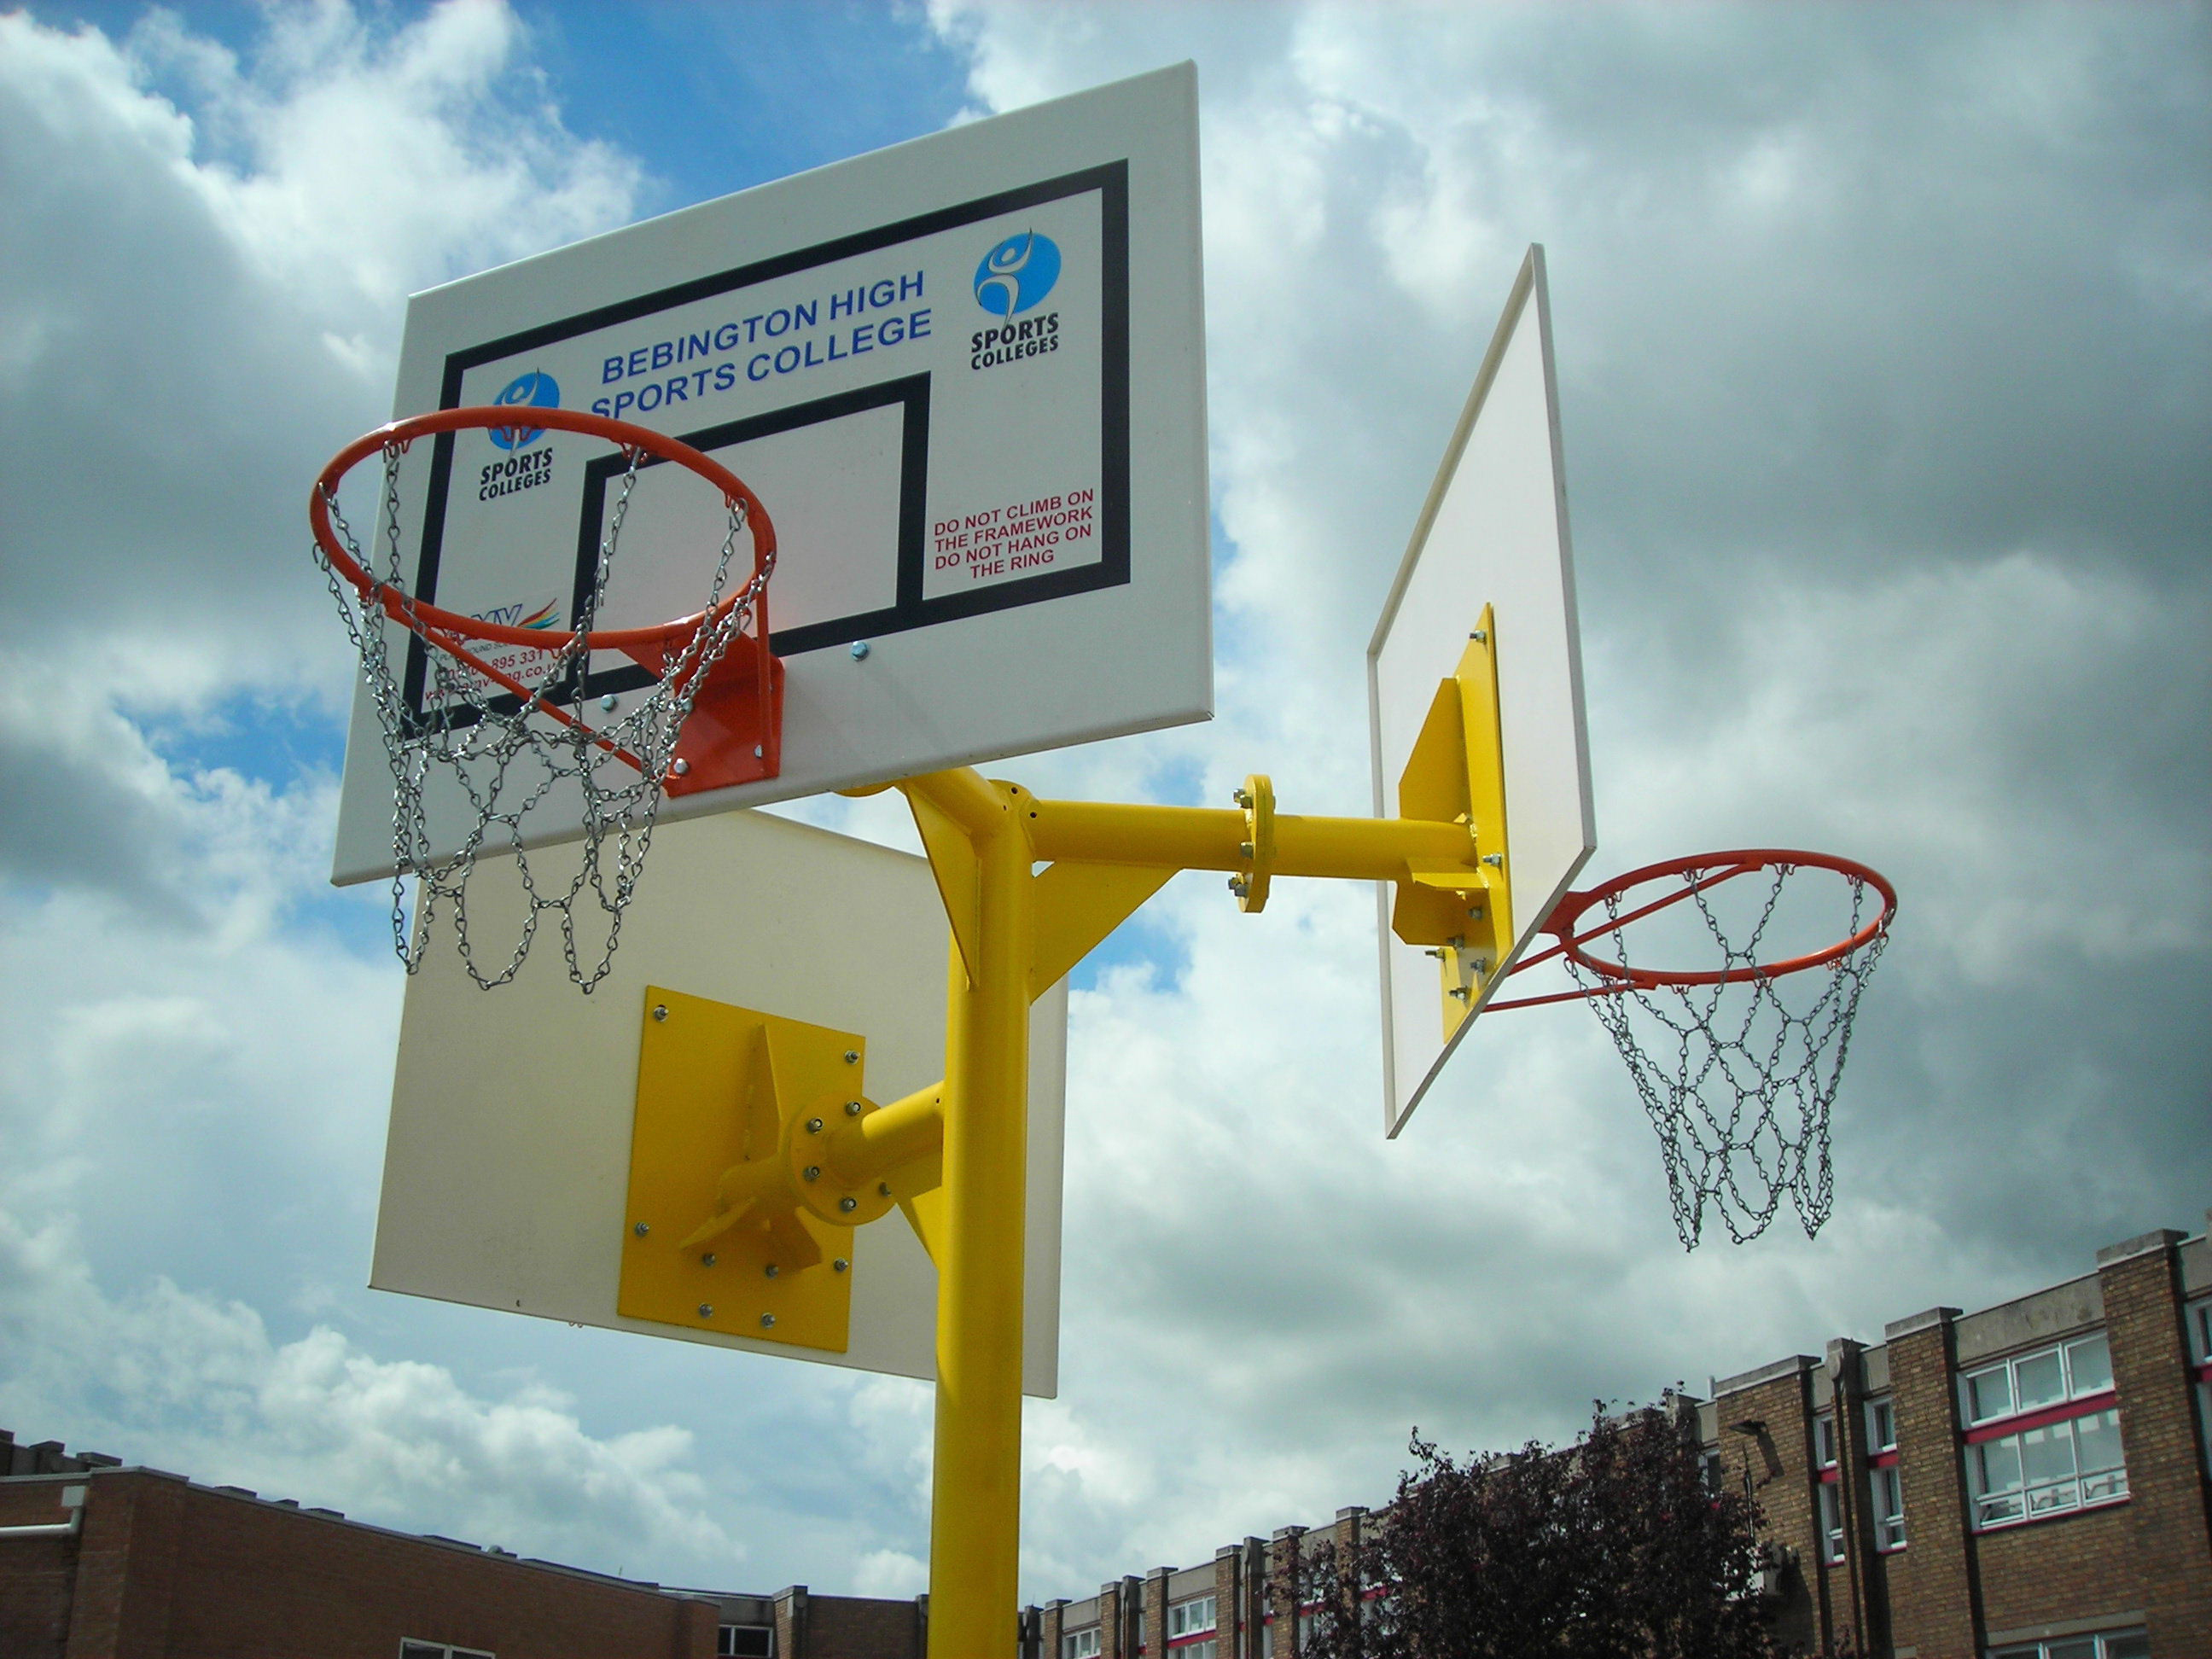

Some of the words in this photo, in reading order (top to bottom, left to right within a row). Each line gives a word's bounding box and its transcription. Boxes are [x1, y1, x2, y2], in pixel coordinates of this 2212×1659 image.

[602, 300, 817, 384] BEBINGTON
[830, 270, 923, 320] HIGH
[971, 311, 1059, 352] SPORTS
[591, 363, 736, 419] SPORTS
[747, 308, 932, 381] COLLEGE
[971, 335, 1059, 370] COLLEGES
[479, 469, 551, 501] COLLEGES
[480, 447, 553, 485] SPORTS
[934, 519, 959, 536] DO
[965, 509, 1001, 530] NOT
[1006, 496, 1062, 520] CLIMB
[1068, 488, 1094, 506] ON
[935, 533, 969, 553] THE
[974, 505, 1093, 544] FRAMEWORK
[934, 552, 960, 570] DO
[966, 543, 1003, 563] NOT
[1008, 531, 1059, 554] HANG
[1065, 523, 1091, 541] ON
[969, 560, 1004, 579] THE
[1010, 549, 1055, 570] RING
[492, 655, 515, 669] 895
